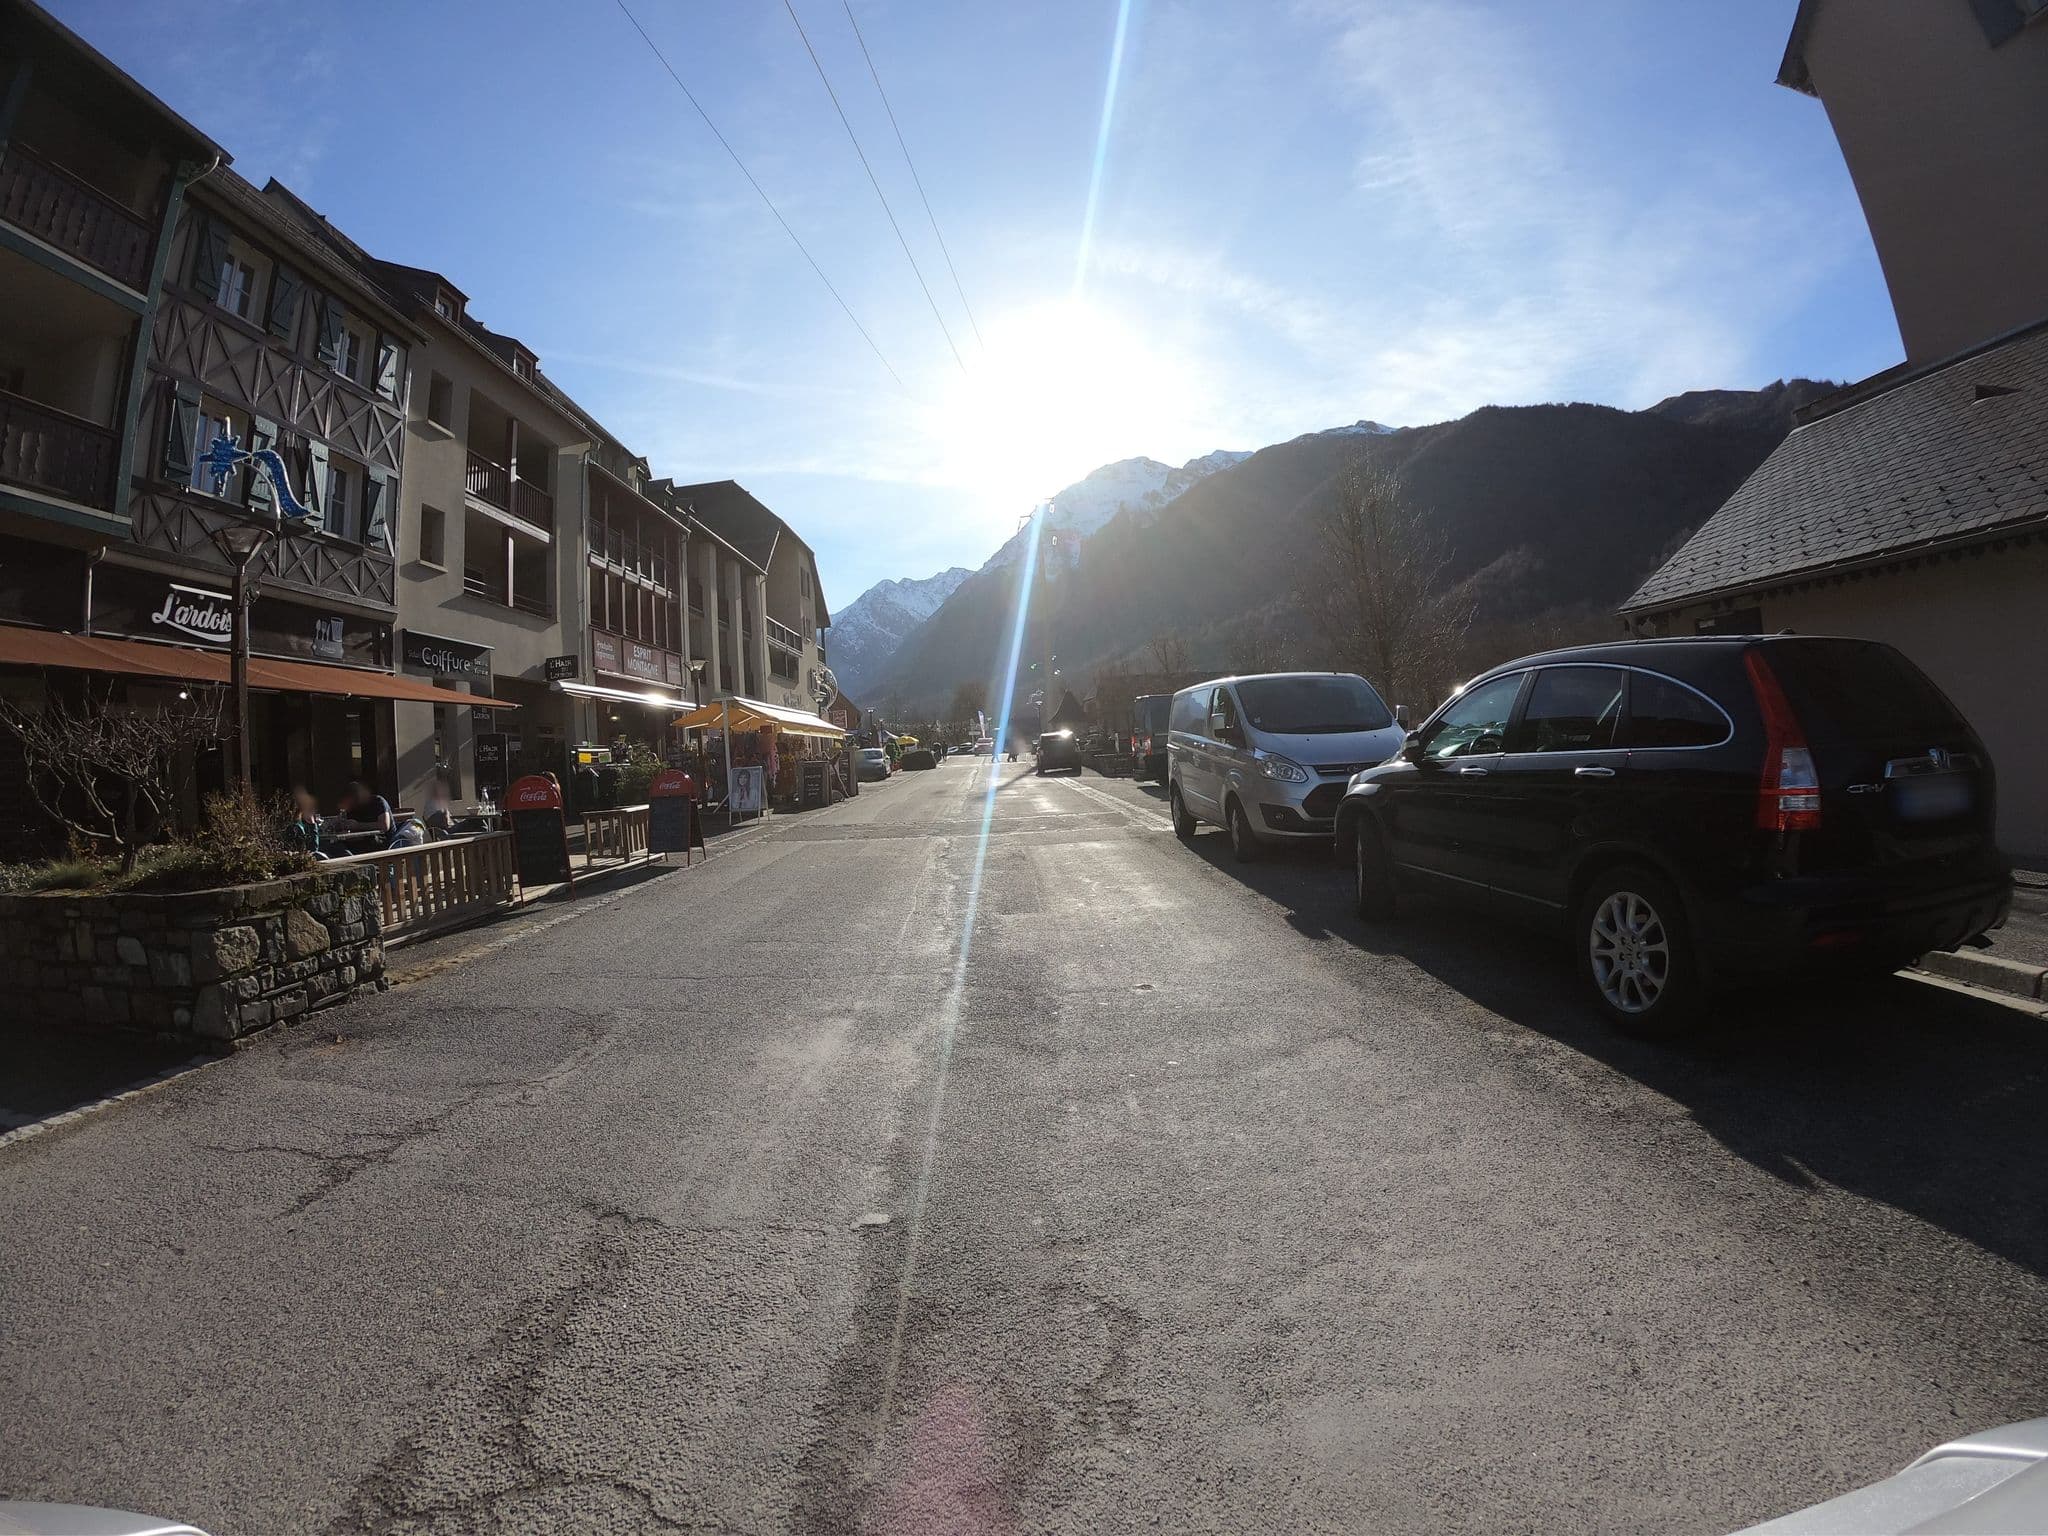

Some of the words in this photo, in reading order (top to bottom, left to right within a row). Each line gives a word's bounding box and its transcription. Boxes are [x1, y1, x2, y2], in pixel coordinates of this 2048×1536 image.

[151, 592, 232, 643] L'ardois
[422, 647, 471, 673] Coiffure
[633, 645, 652, 661] ESPRIT
[627, 657, 659, 676] MONTAGNE
[520, 790, 547, 802] Coca-Cola
